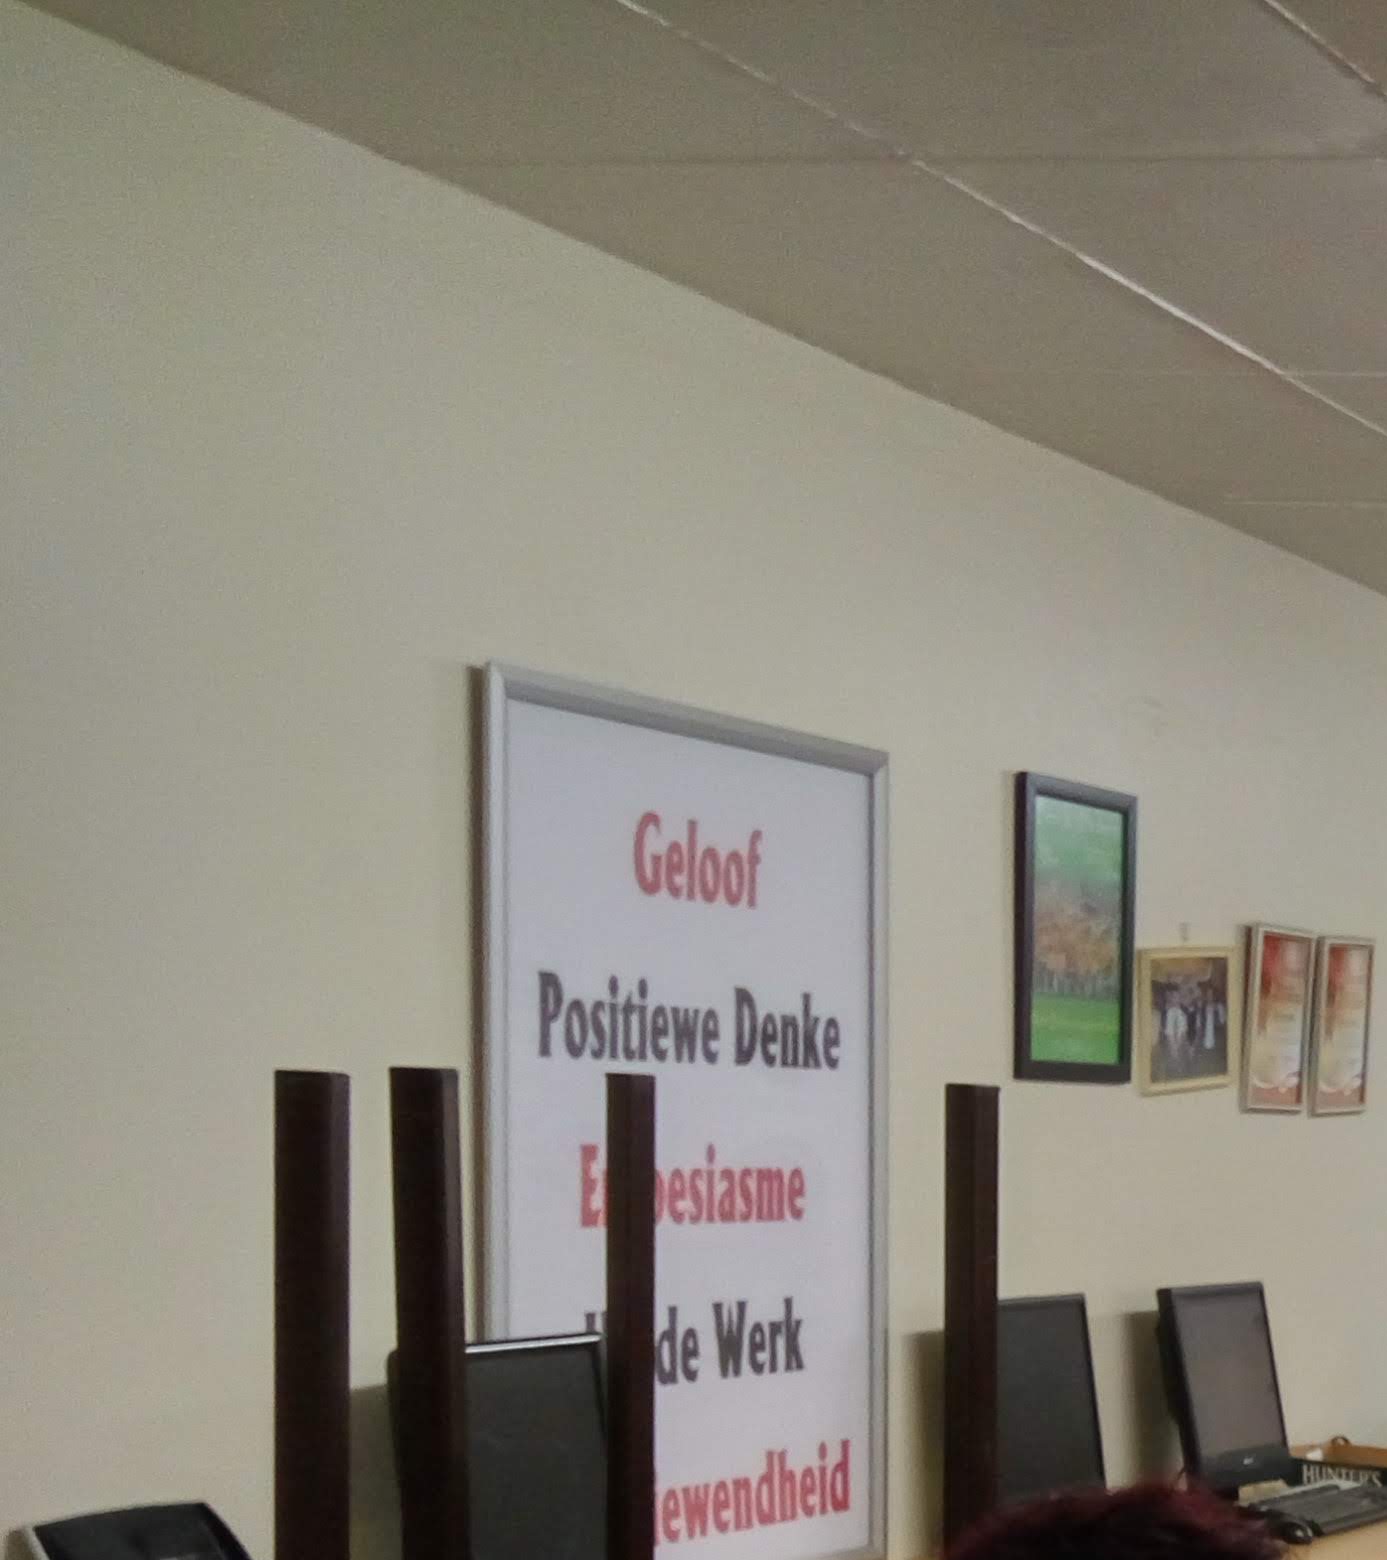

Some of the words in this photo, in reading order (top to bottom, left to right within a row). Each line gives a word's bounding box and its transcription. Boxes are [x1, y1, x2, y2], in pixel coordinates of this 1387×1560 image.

[634, 812, 763, 909] Geloof
[538, 971, 720, 1065] Positiewe
[733, 986, 841, 1070] Denke
[580, 1143, 806, 1228] Eesiasme
[712, 1296, 805, 1380] Werk
[655, 1439, 851, 1546] ewendheid
